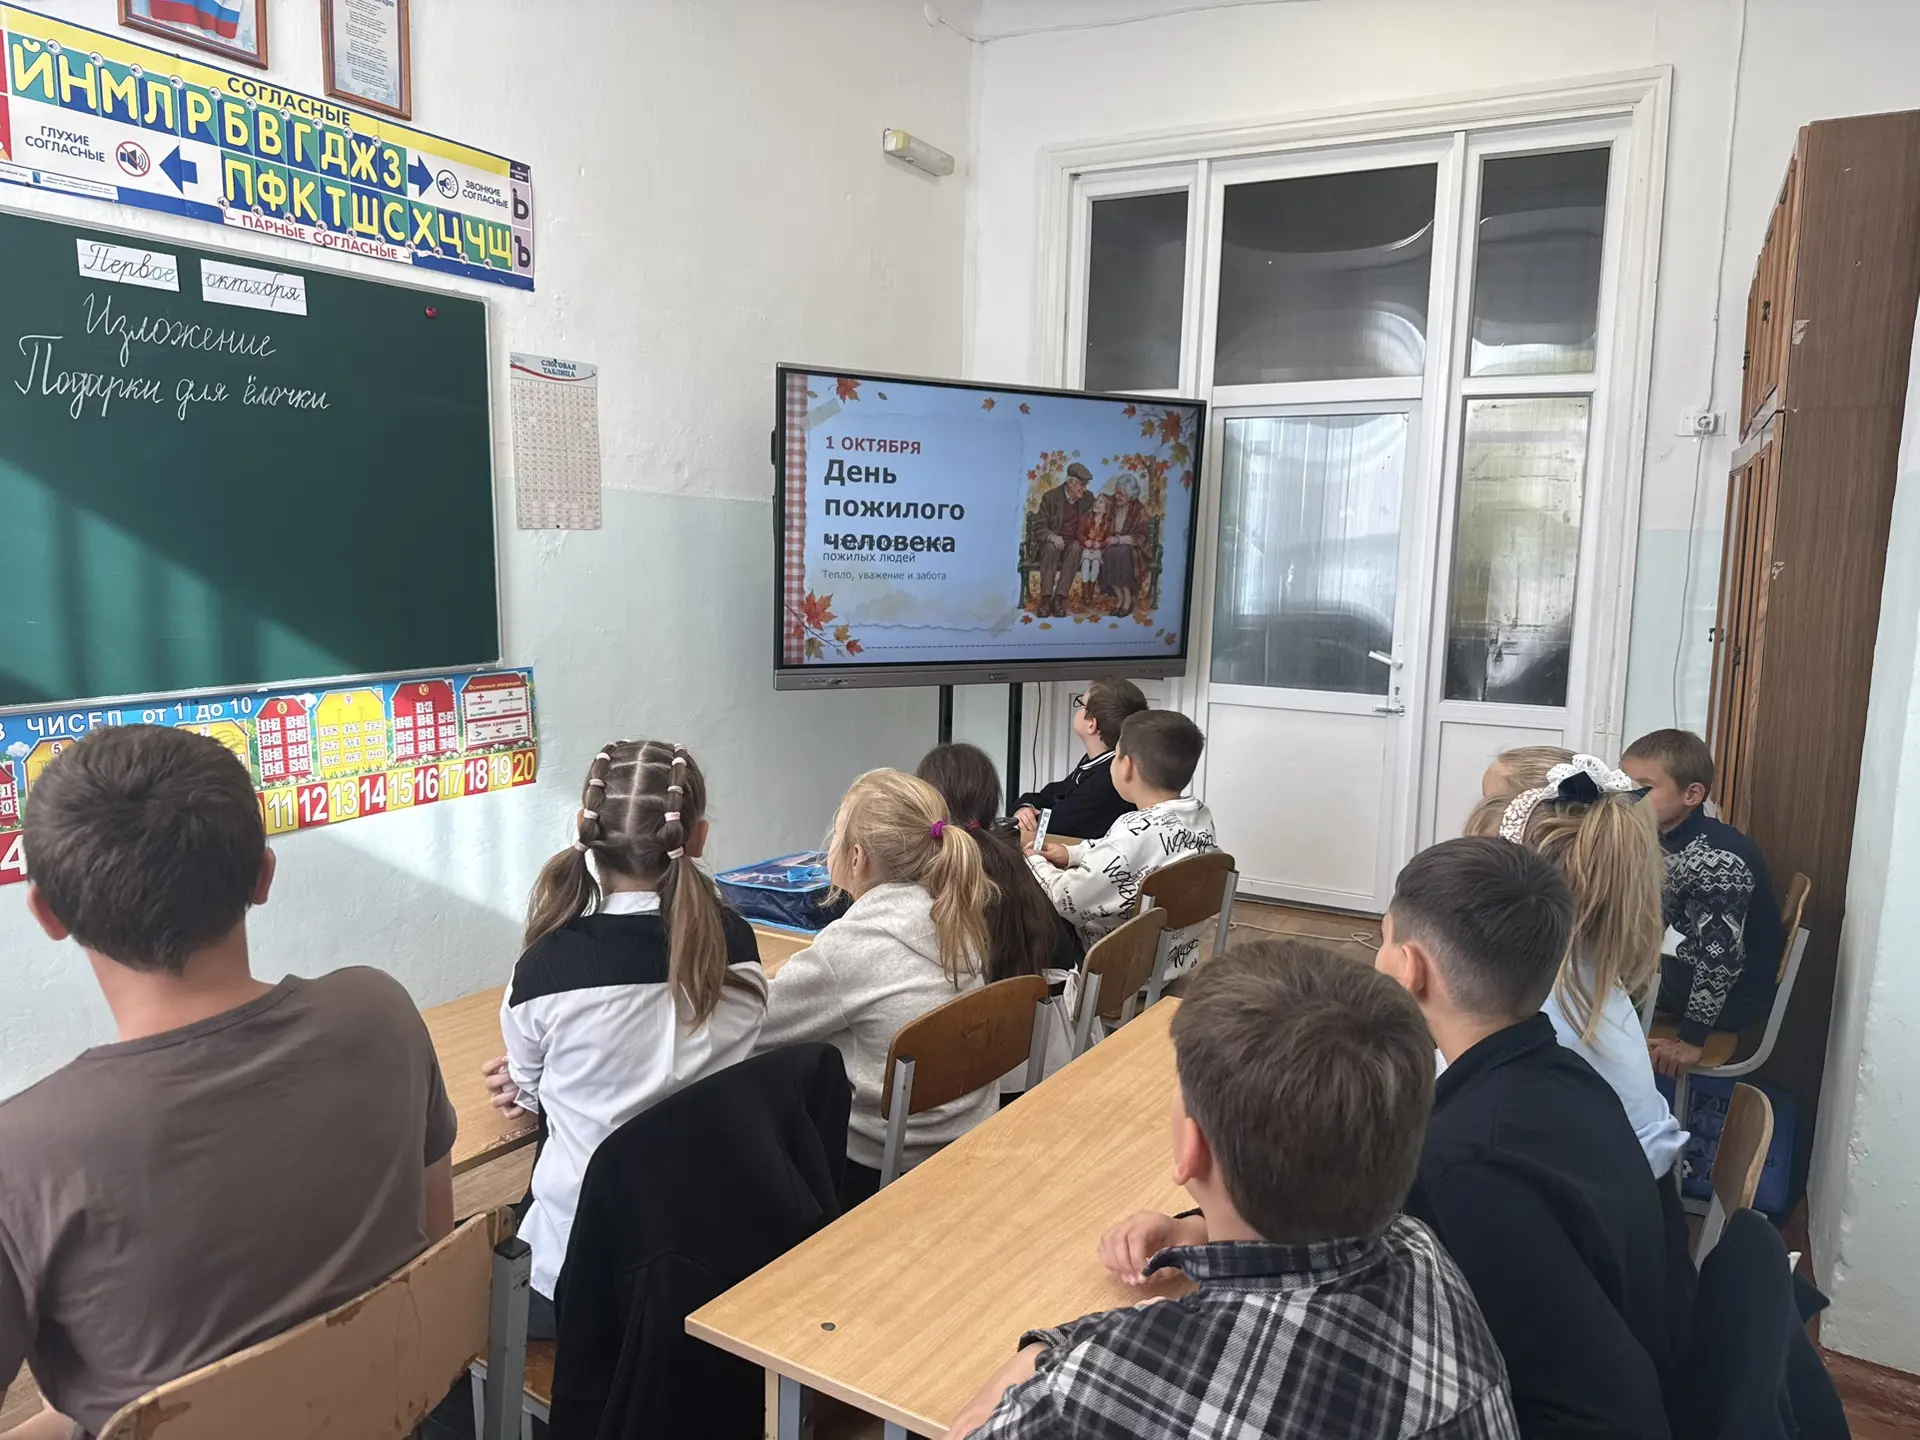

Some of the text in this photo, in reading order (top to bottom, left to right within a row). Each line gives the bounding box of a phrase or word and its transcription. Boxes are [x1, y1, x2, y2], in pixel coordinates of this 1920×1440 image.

[227, 77, 350, 126] СОГЛАСНЫЕ
[40, 125, 90, 147] ГЛУХИЕ
[25, 135, 106, 163] СОГЛАСНЫЕ
[462, 189, 509, 209] СОГЛАСНЫЕ
[464, 180, 501, 198] ЗВОНКИЕ
[241, 214, 398, 260] ПАРНЫЕ СОГЛАСНЫЕ
[84, 243, 301, 307] Первое октября
[83, 292, 277, 367] Изложение
[540, 359, 577, 371] СЛОГОВАЯ
[542, 367, 576, 378] ТАБЛИЦА
[14, 334, 331, 420] Подарки для ёлочки
[825, 435, 921, 455] 1 ОКТЯБРЯ
[823, 458, 897, 487] День
[824, 498, 965, 521] пожилого
[823, 533, 956, 553] человека
[822, 552, 916, 564] пожилых людей
[822, 569, 947, 582] Тепло, уважение и забота
[142, 708, 166, 724] от
[174, 703, 184, 720] 1
[196, 703, 223, 722] до
[230, 696, 252, 715] 10
[53, 743, 60, 755] 5
[268, 751, 535, 828] 11 12 13 14 15 16 17 18 19 20
[0, 834, 28, 876] 4
